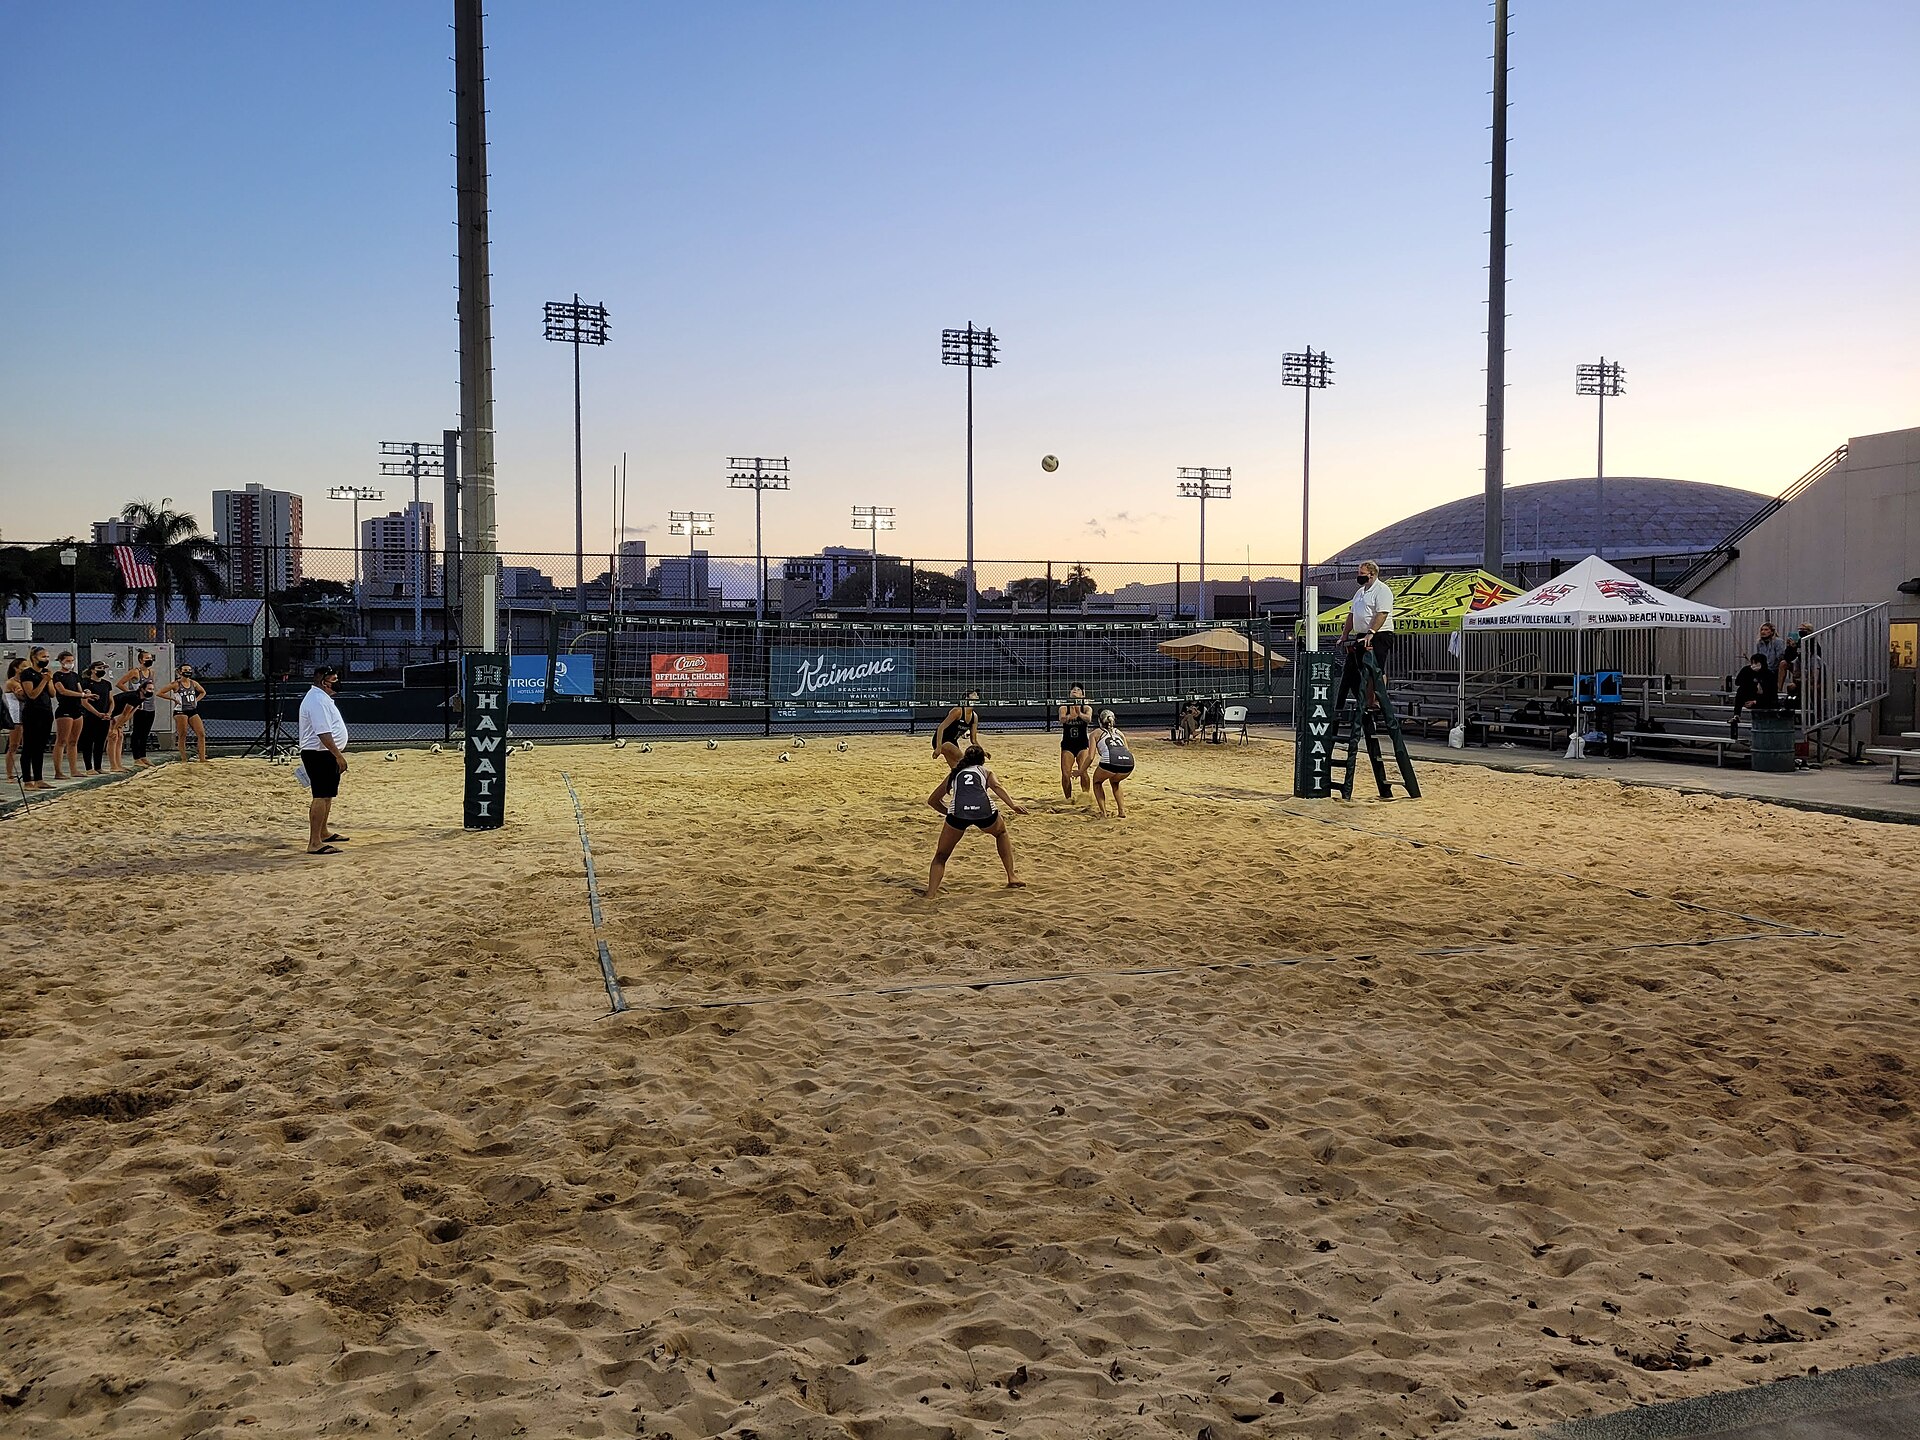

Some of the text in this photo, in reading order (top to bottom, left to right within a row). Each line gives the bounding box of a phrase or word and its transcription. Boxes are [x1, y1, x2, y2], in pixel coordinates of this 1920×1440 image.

[1500, 615, 1519, 625] BEACH
[1522, 615, 1561, 624] VOLLEYBALL
[1629, 613, 1656, 622] BEACH
[1659, 613, 1710, 623] VOLLEYBALL
[1393, 619, 1439, 629] LEYBALL
[790, 654, 896, 697] Kaimana
[186, 694, 195, 702] 10
[963, 773, 974, 785] 2
